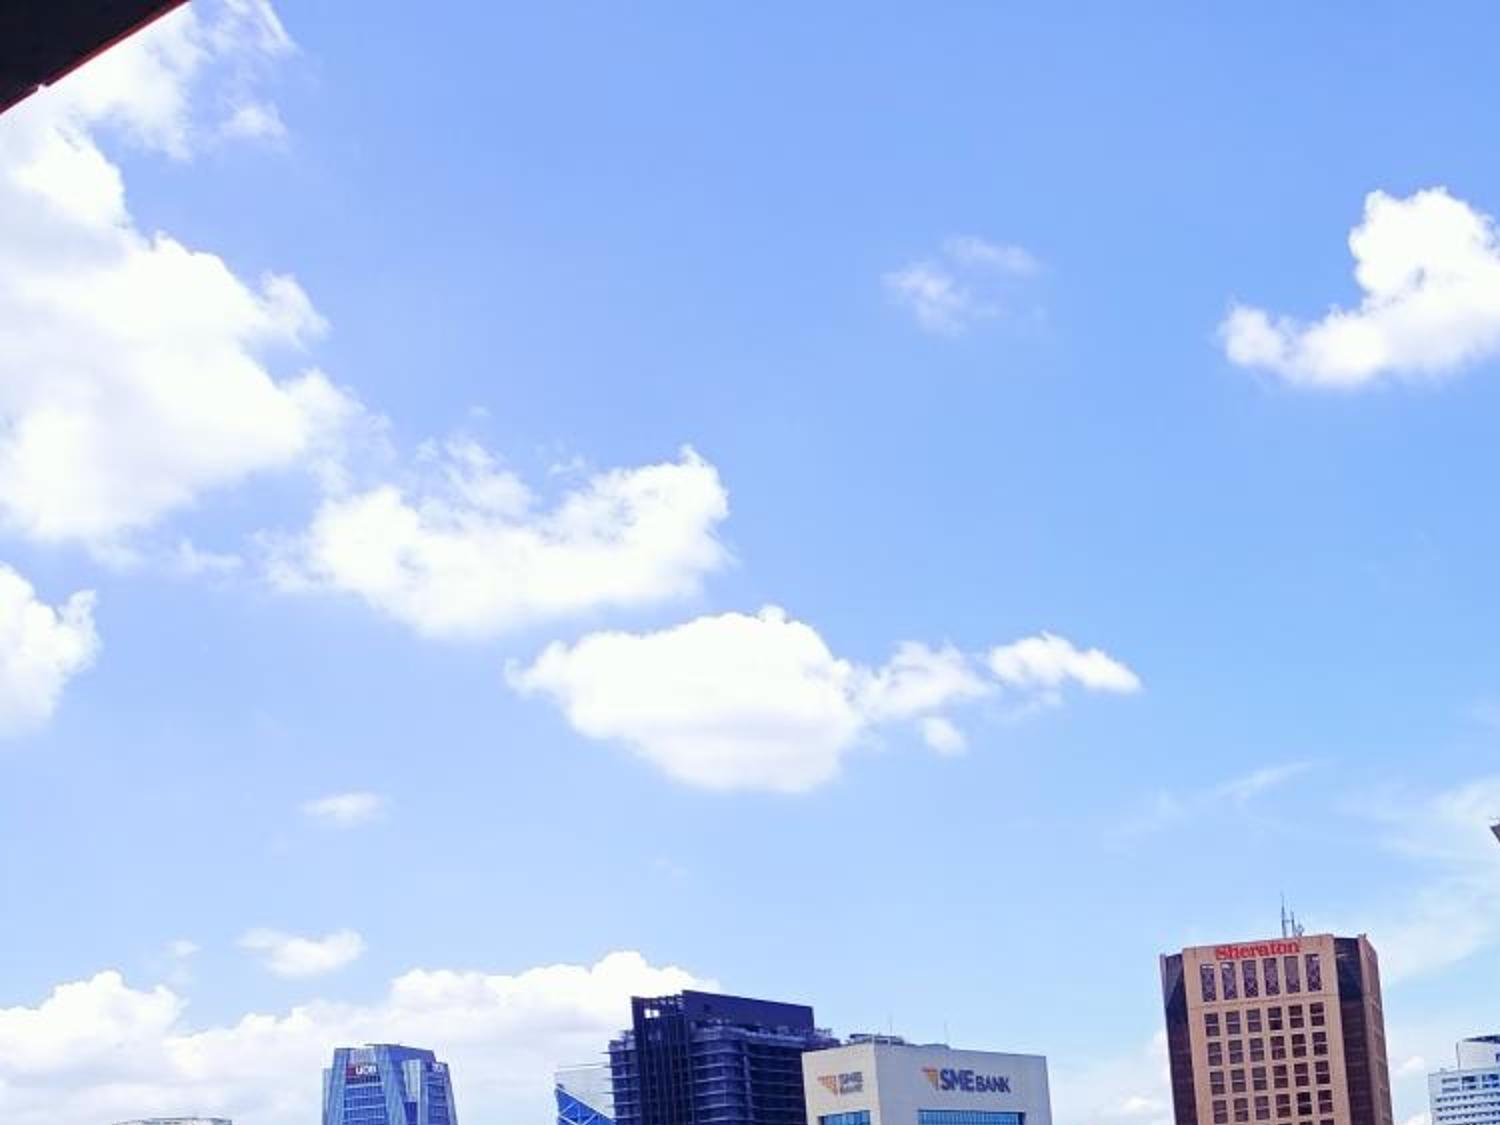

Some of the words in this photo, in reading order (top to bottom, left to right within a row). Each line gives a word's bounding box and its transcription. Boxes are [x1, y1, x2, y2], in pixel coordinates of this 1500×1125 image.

[1215, 940, 1300, 960] Sheraton
[939, 1068, 975, 1092] SME
[976, 1075, 1011, 1094] BANK
